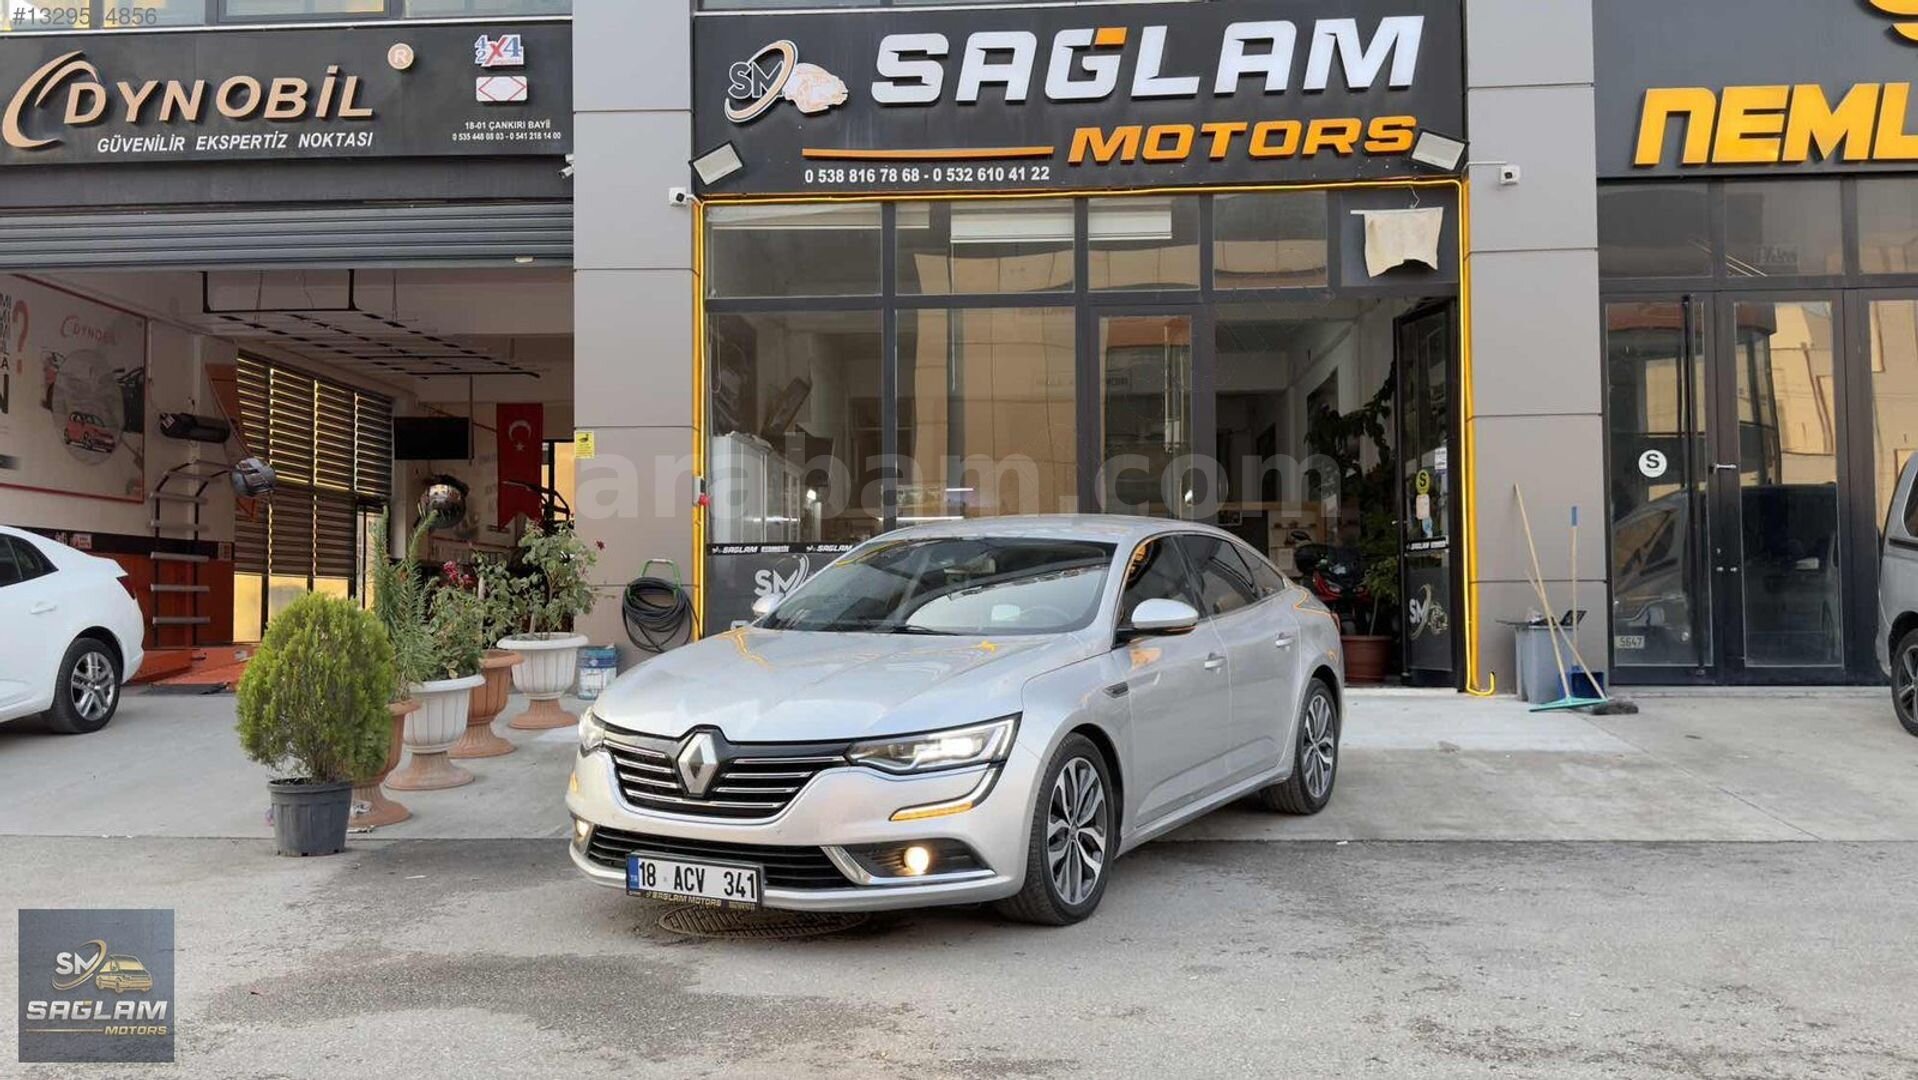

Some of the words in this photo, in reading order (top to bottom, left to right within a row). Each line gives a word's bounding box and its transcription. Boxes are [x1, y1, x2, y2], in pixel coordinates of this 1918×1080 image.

[488, 120, 526, 131] ÇANKIRI
[97, 133, 185, 154] GÜVENİLİR
[195, 131, 288, 151] EKSPERTİZ
[298, 131, 373, 148] NOKTASI
[1067, 115, 1417, 163] MOTORS
[804, 170, 814, 184] 0
[818, 169, 845, 183] 538
[849, 169, 876, 183] 816
[879, 168, 898, 182] 78
[902, 168, 920, 182] 68
[932, 168, 942, 182] 0
[946, 168, 973, 182] 532
[977, 167, 1004, 181] 610
[1008, 167, 1026, 181] 41
[1030, 166, 1050, 181] 22
[1646, 453, 1660, 469] S
[639, 861, 656, 887] 18
[673, 865, 705, 893] ACV
[723, 871, 755, 899] 341
